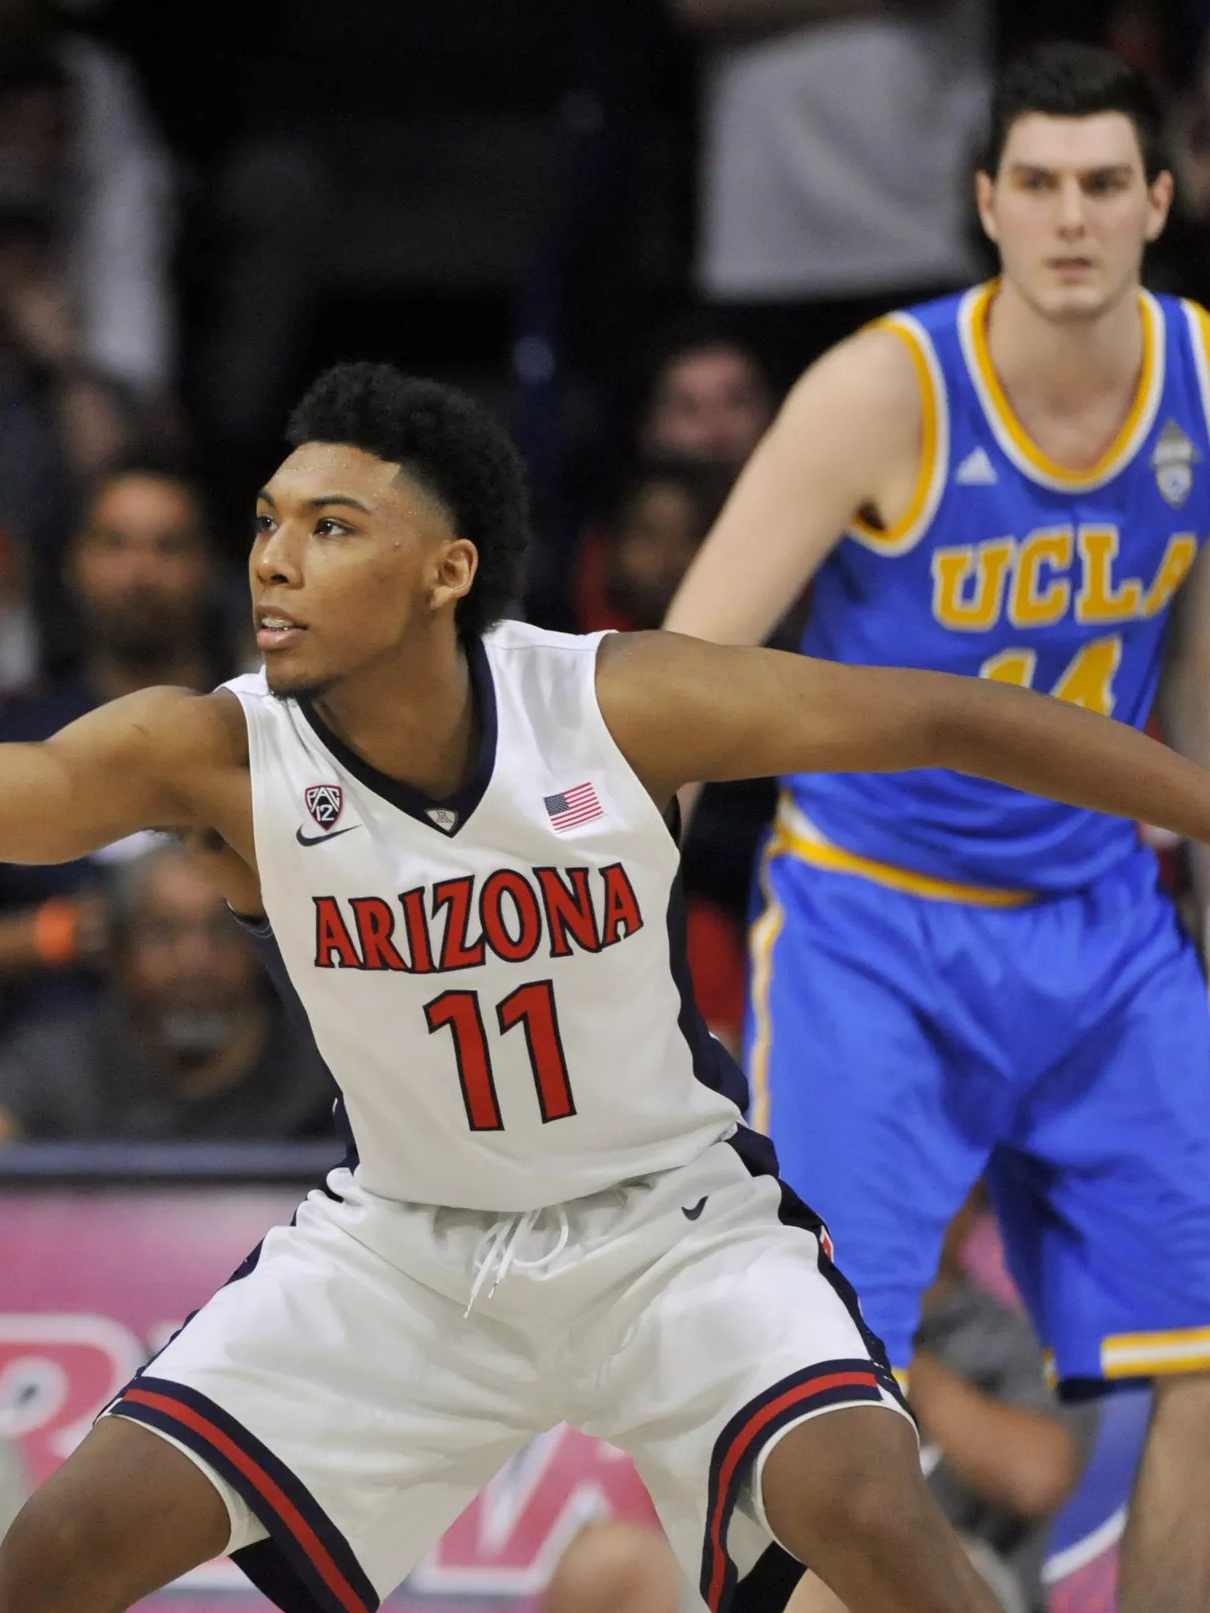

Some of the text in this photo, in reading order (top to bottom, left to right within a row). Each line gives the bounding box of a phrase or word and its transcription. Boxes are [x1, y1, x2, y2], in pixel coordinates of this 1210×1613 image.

[315, 804, 335, 822] 12
[312, 862, 644, 973] ARIZONA
[423, 979, 577, 1131] 11
